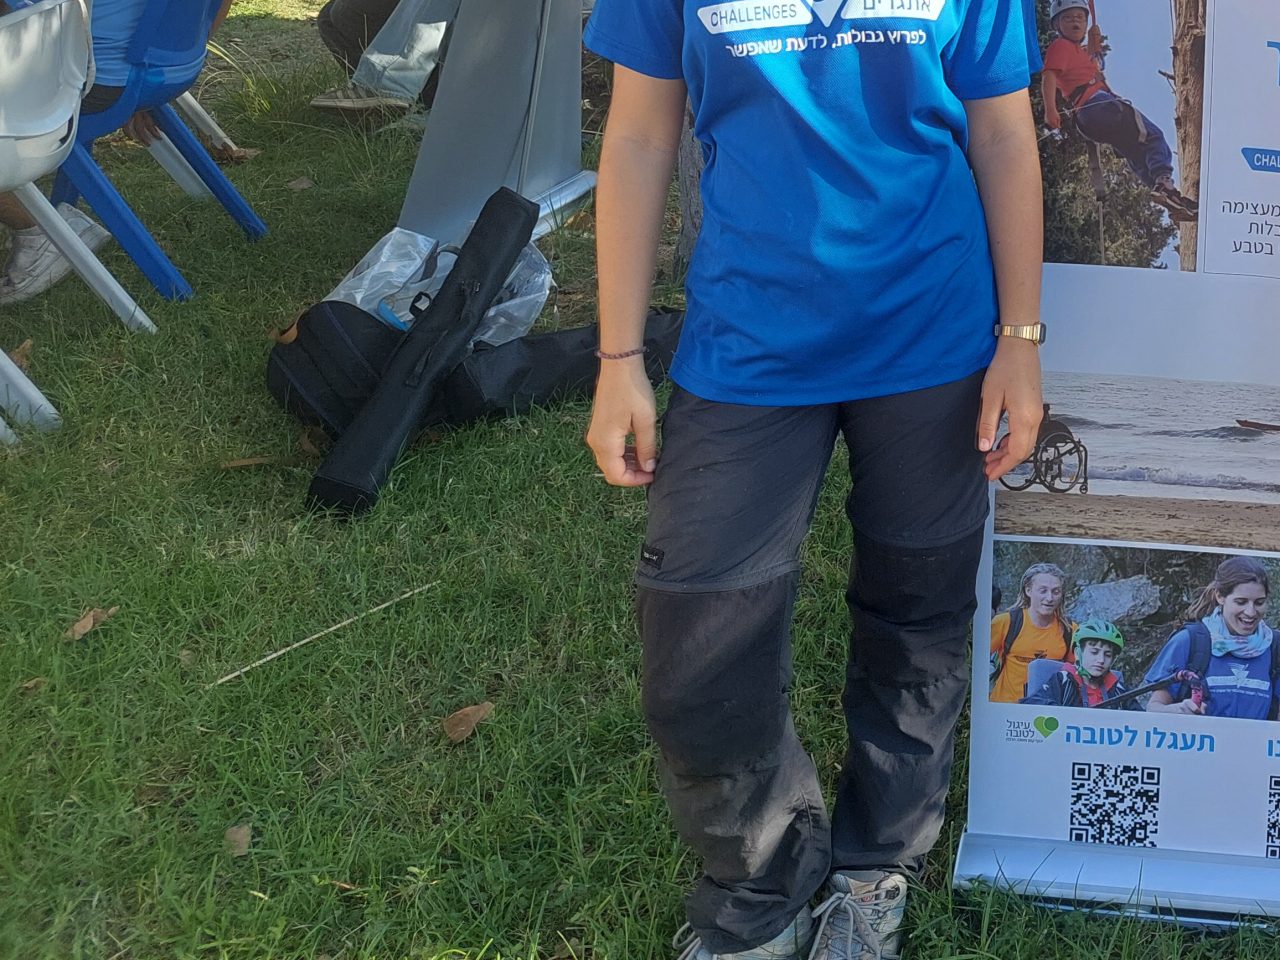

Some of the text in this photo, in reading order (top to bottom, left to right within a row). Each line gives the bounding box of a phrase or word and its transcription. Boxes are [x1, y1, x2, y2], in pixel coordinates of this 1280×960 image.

[710, 3, 798, 27] CHALLENGES
[725, 28, 927, 58] לפרוץ גבולות, לדעת שאפשר
[1231, 239, 1274, 256] בטבע
[1005, 728, 1035, 739] לטובה
[1006, 719, 1031, 730] עיגול
[1065, 724, 1216, 753] תעגלו לטובה
